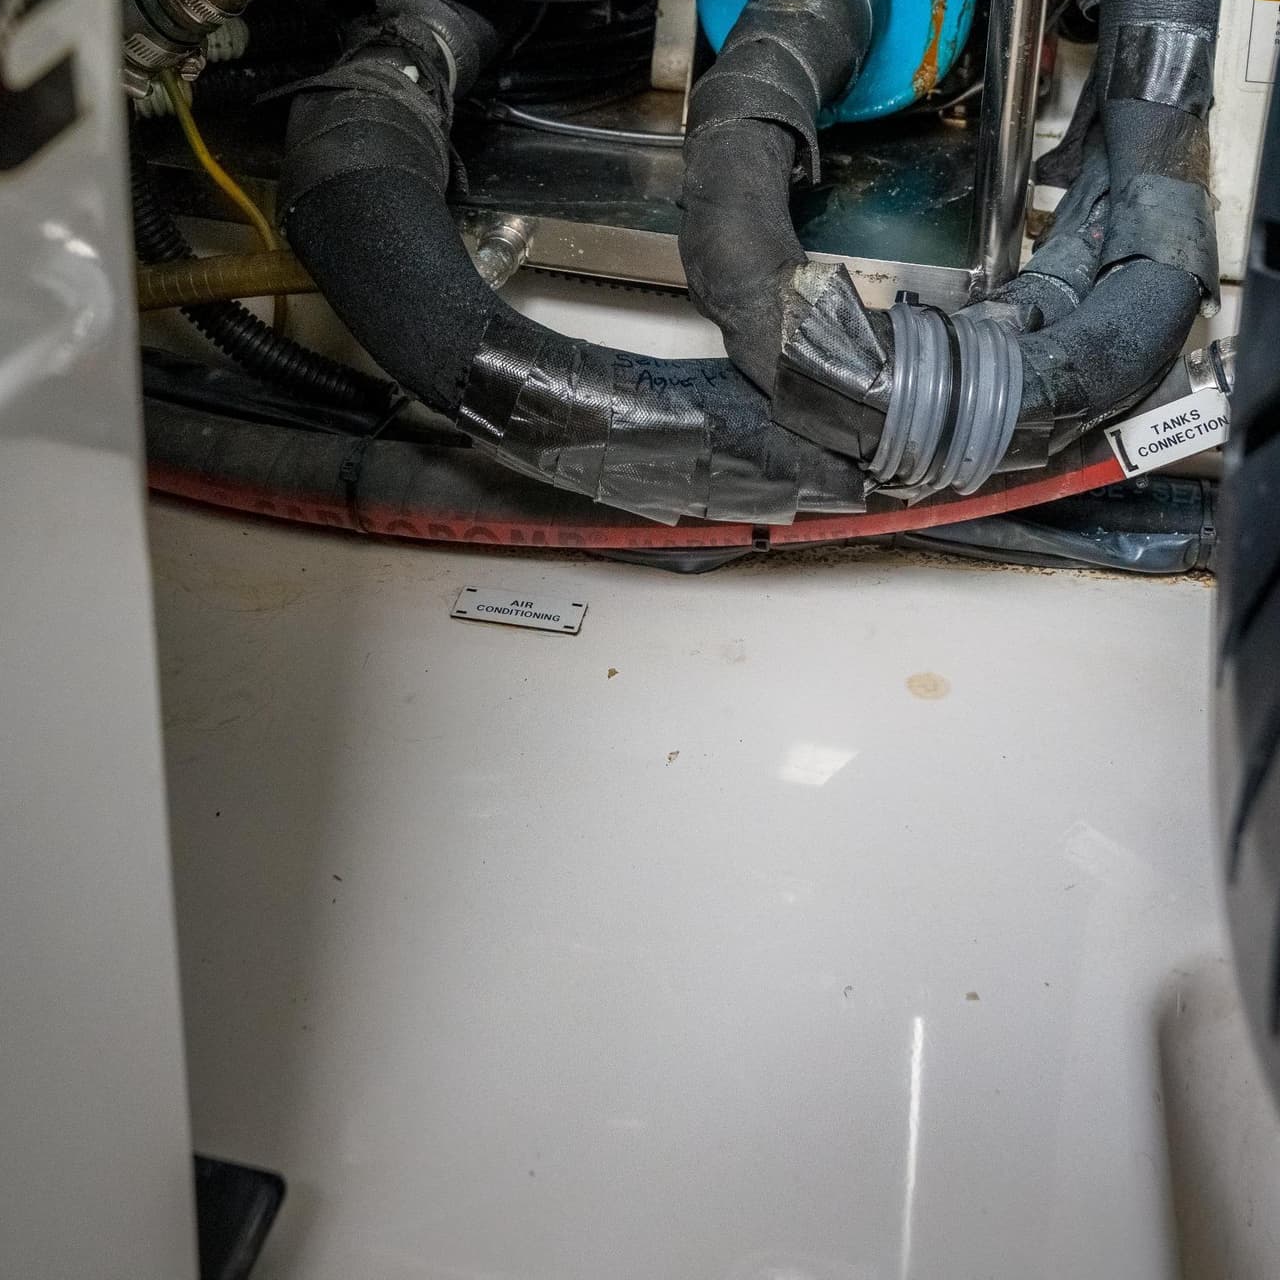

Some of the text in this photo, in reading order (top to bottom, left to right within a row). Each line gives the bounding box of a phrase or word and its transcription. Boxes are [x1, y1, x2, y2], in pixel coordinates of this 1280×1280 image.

[1150, 409, 1201, 435] TANKS
[1138, 415, 1230, 457] CONNECTION
[476, 604, 561, 622] CONDITIONING
[510, 600, 534, 609] AIR
